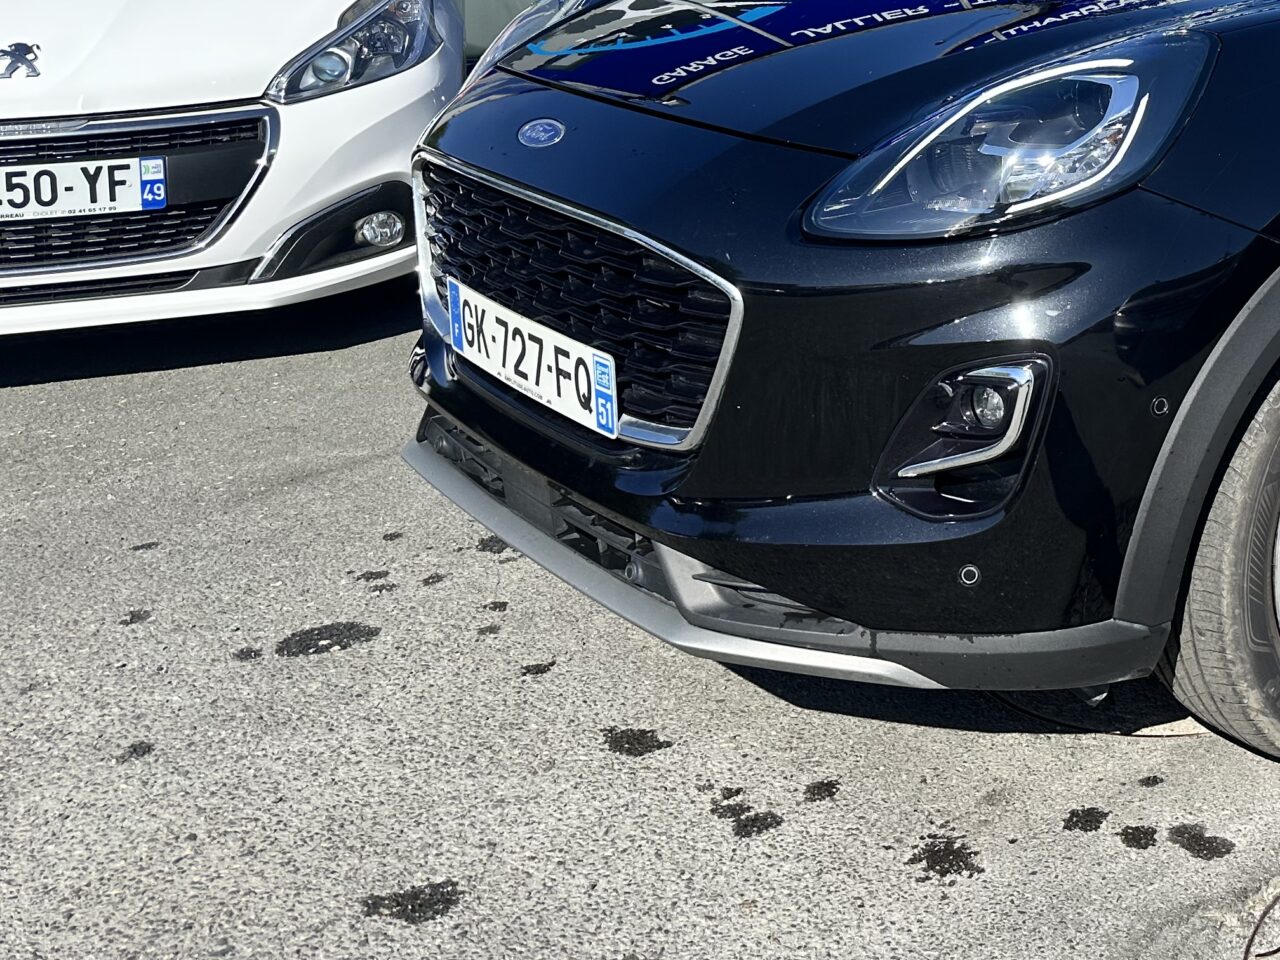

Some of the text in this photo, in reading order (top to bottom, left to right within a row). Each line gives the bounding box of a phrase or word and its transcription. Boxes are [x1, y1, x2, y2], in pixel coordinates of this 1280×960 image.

[0, 163, 131, 209] 50-YF
[143, 182, 165, 201] 49
[454, 323, 459, 337] F
[462, 298, 593, 415] GK-727-FQ
[599, 397, 613, 434] 51
